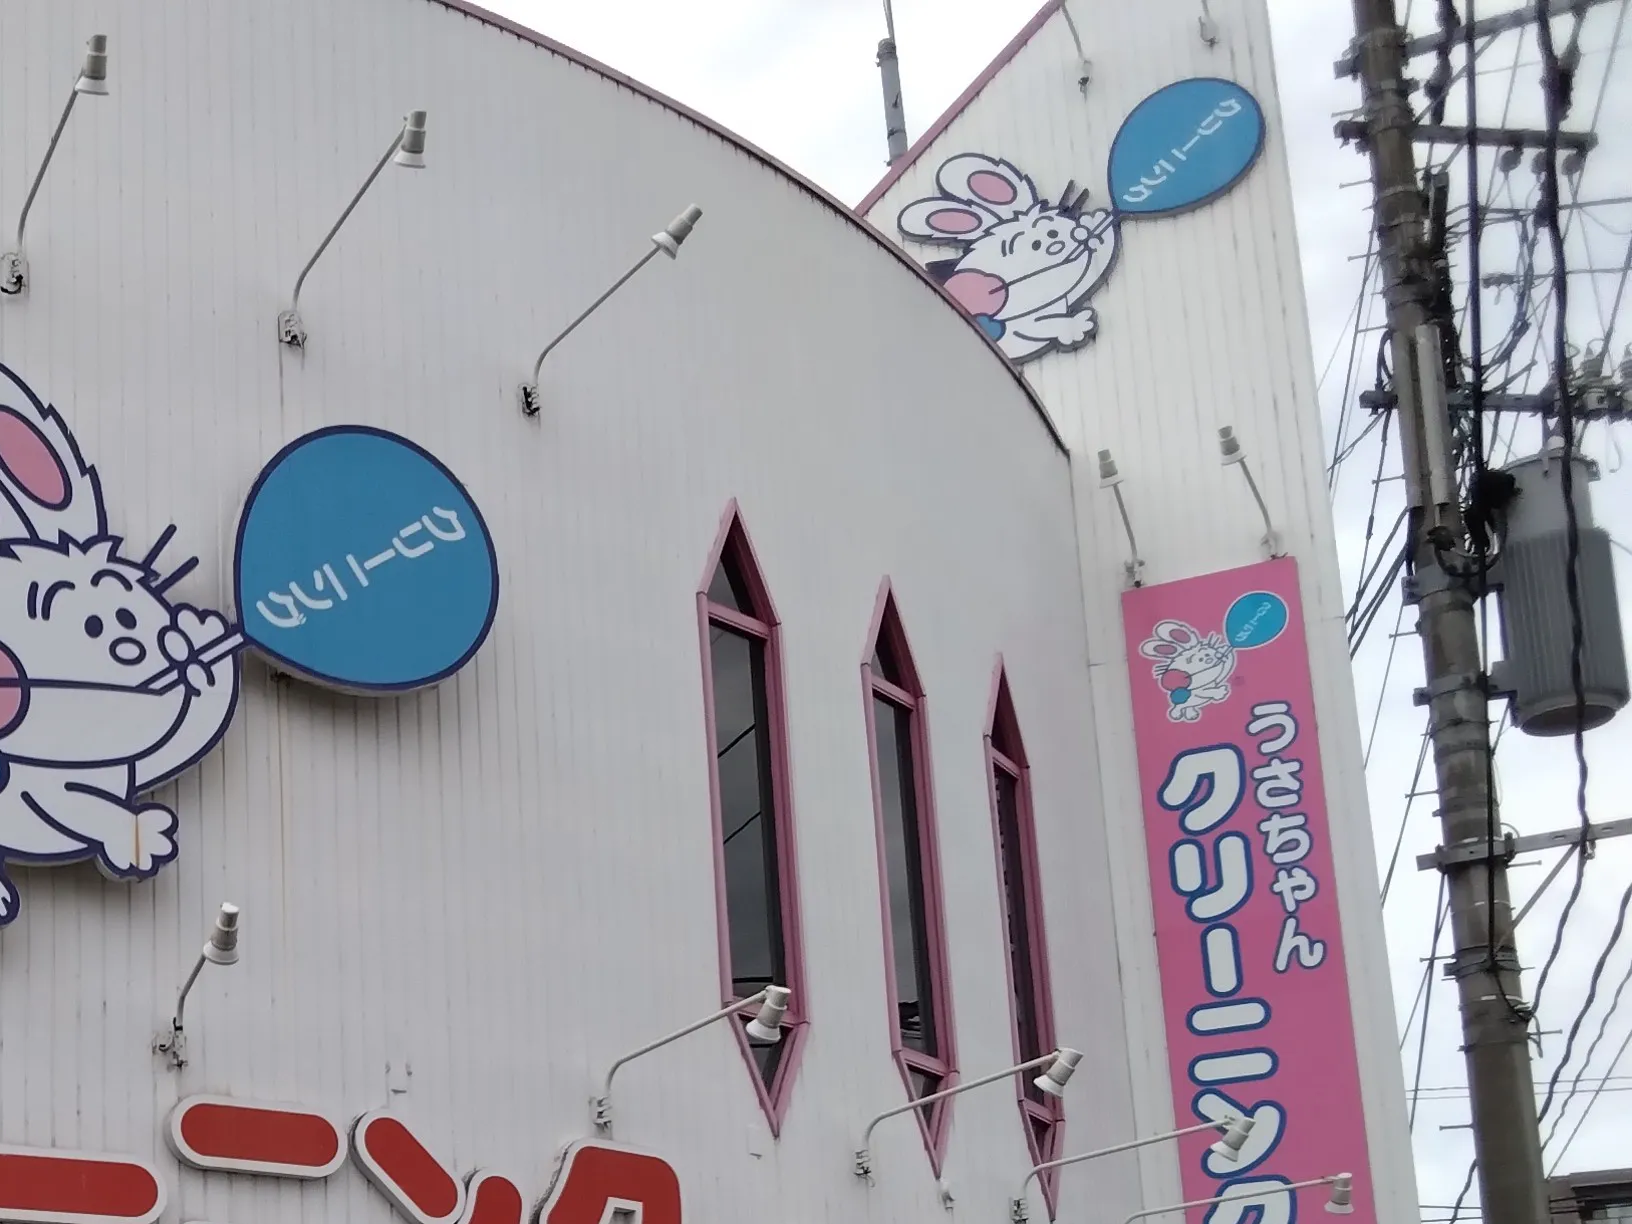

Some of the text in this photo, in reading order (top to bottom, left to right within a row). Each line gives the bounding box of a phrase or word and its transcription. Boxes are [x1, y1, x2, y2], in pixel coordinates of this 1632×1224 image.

[256, 506, 466, 628] クリーニング
[1247, 701, 1327, 973] うさちゃん
